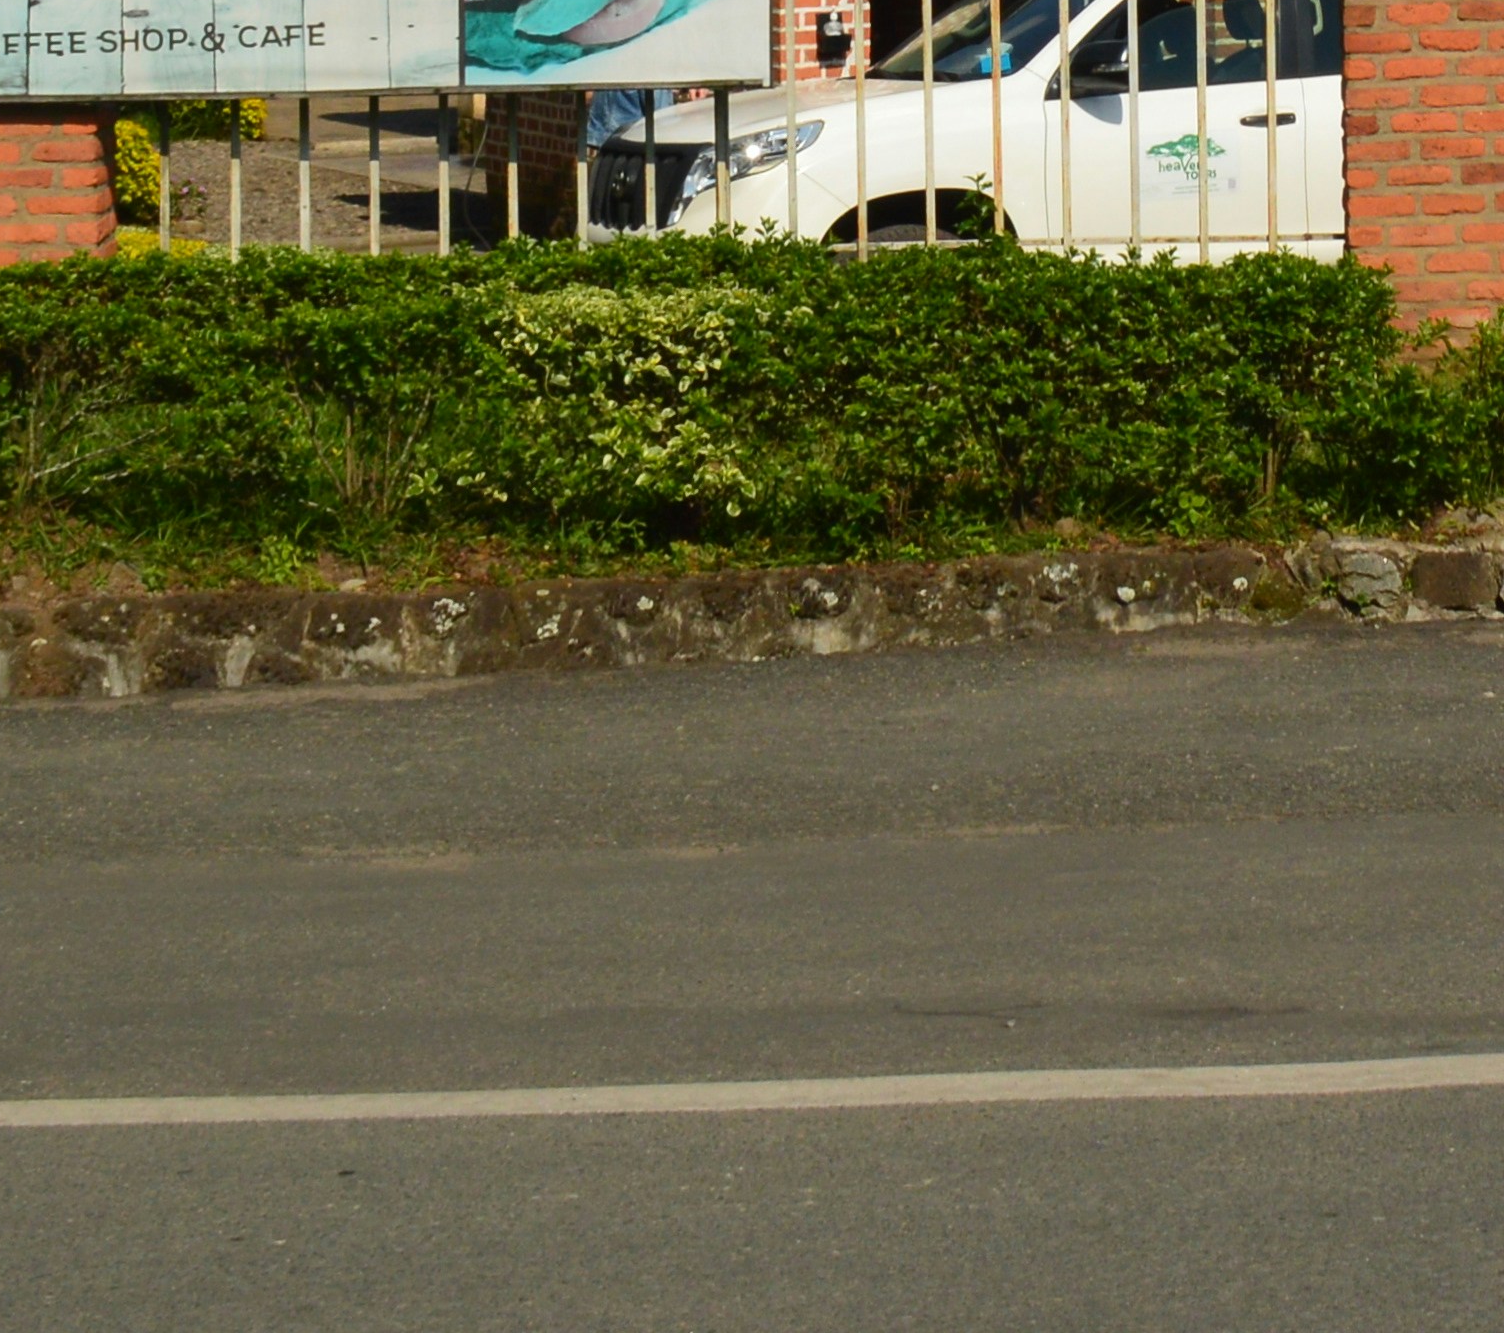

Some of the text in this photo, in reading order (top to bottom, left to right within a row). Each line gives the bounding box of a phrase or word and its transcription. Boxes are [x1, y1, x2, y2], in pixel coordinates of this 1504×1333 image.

[98, 27, 188, 53] SHOP
[200, 22, 225, 53] &
[1158, 159, 1201, 173] heave
[1184, 169, 1217, 181] TORS
